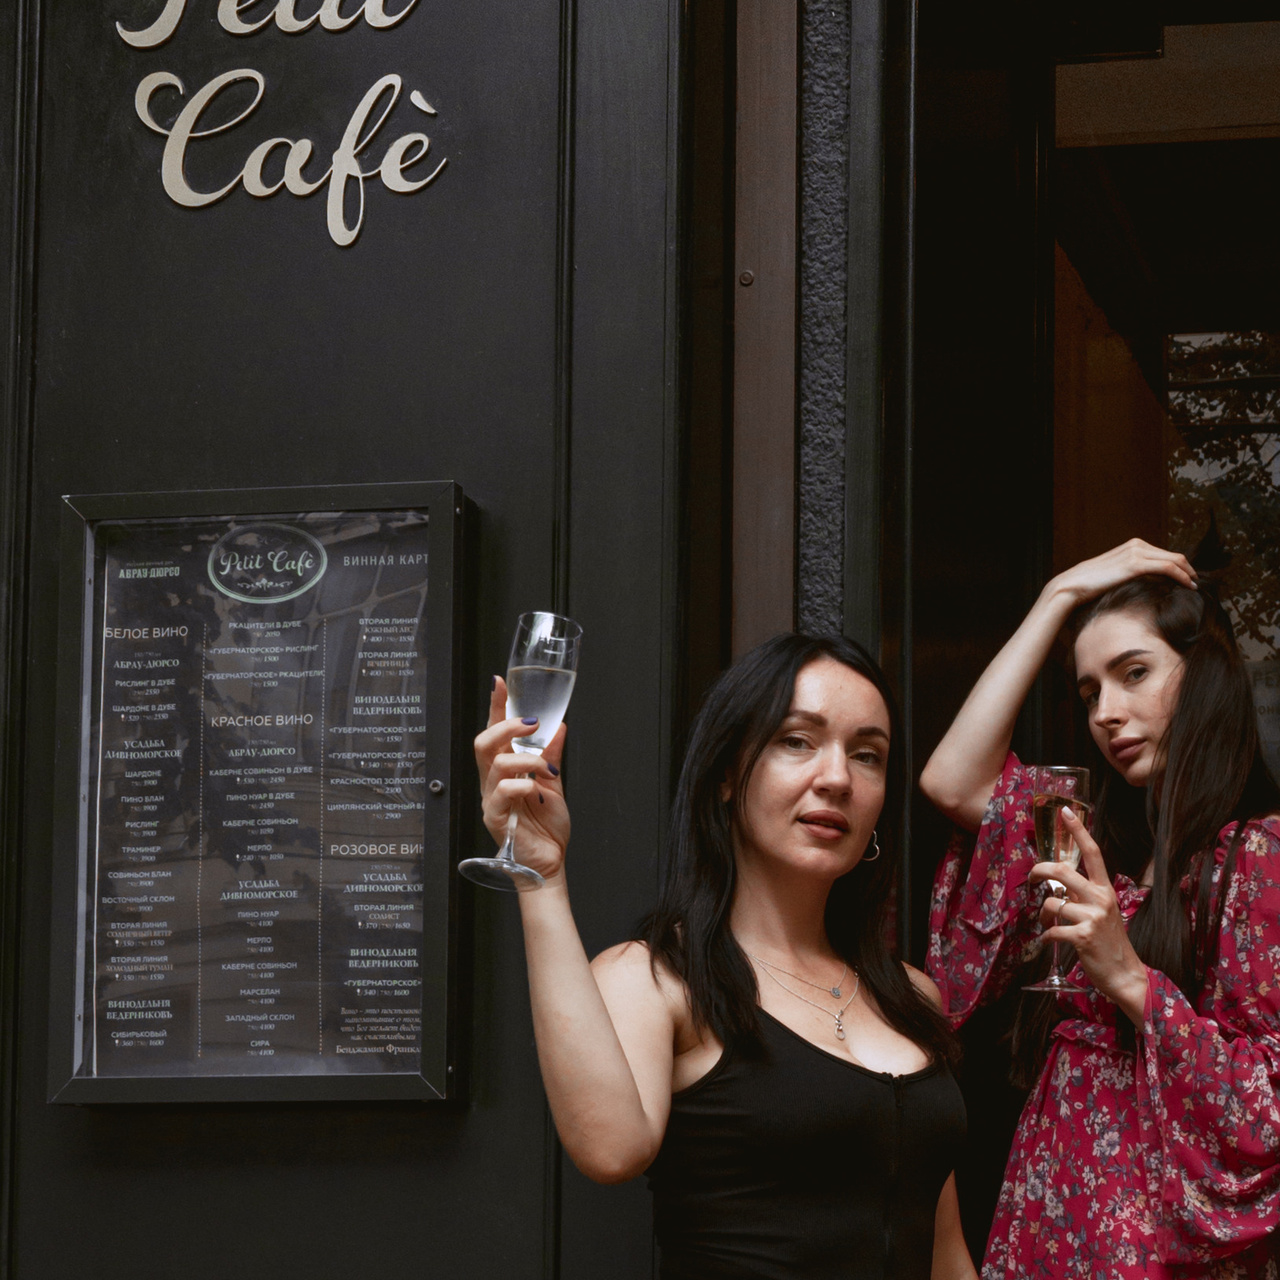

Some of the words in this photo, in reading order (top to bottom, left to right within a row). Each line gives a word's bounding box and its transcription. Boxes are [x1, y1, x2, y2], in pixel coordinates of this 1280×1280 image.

[134, 68, 448, 248] Cafè
[219, 552, 264, 575] Petit
[343, 555, 394, 566] ВИННАЯ
[105, 627, 149, 639] БЕЛОЕ
[152, 626, 188, 638] ВИНО
[211, 715, 272, 727] КРАСНОЕ
[276, 714, 313, 726] ВИНО
[330, 844, 397, 855] РОЗОВОЕ
